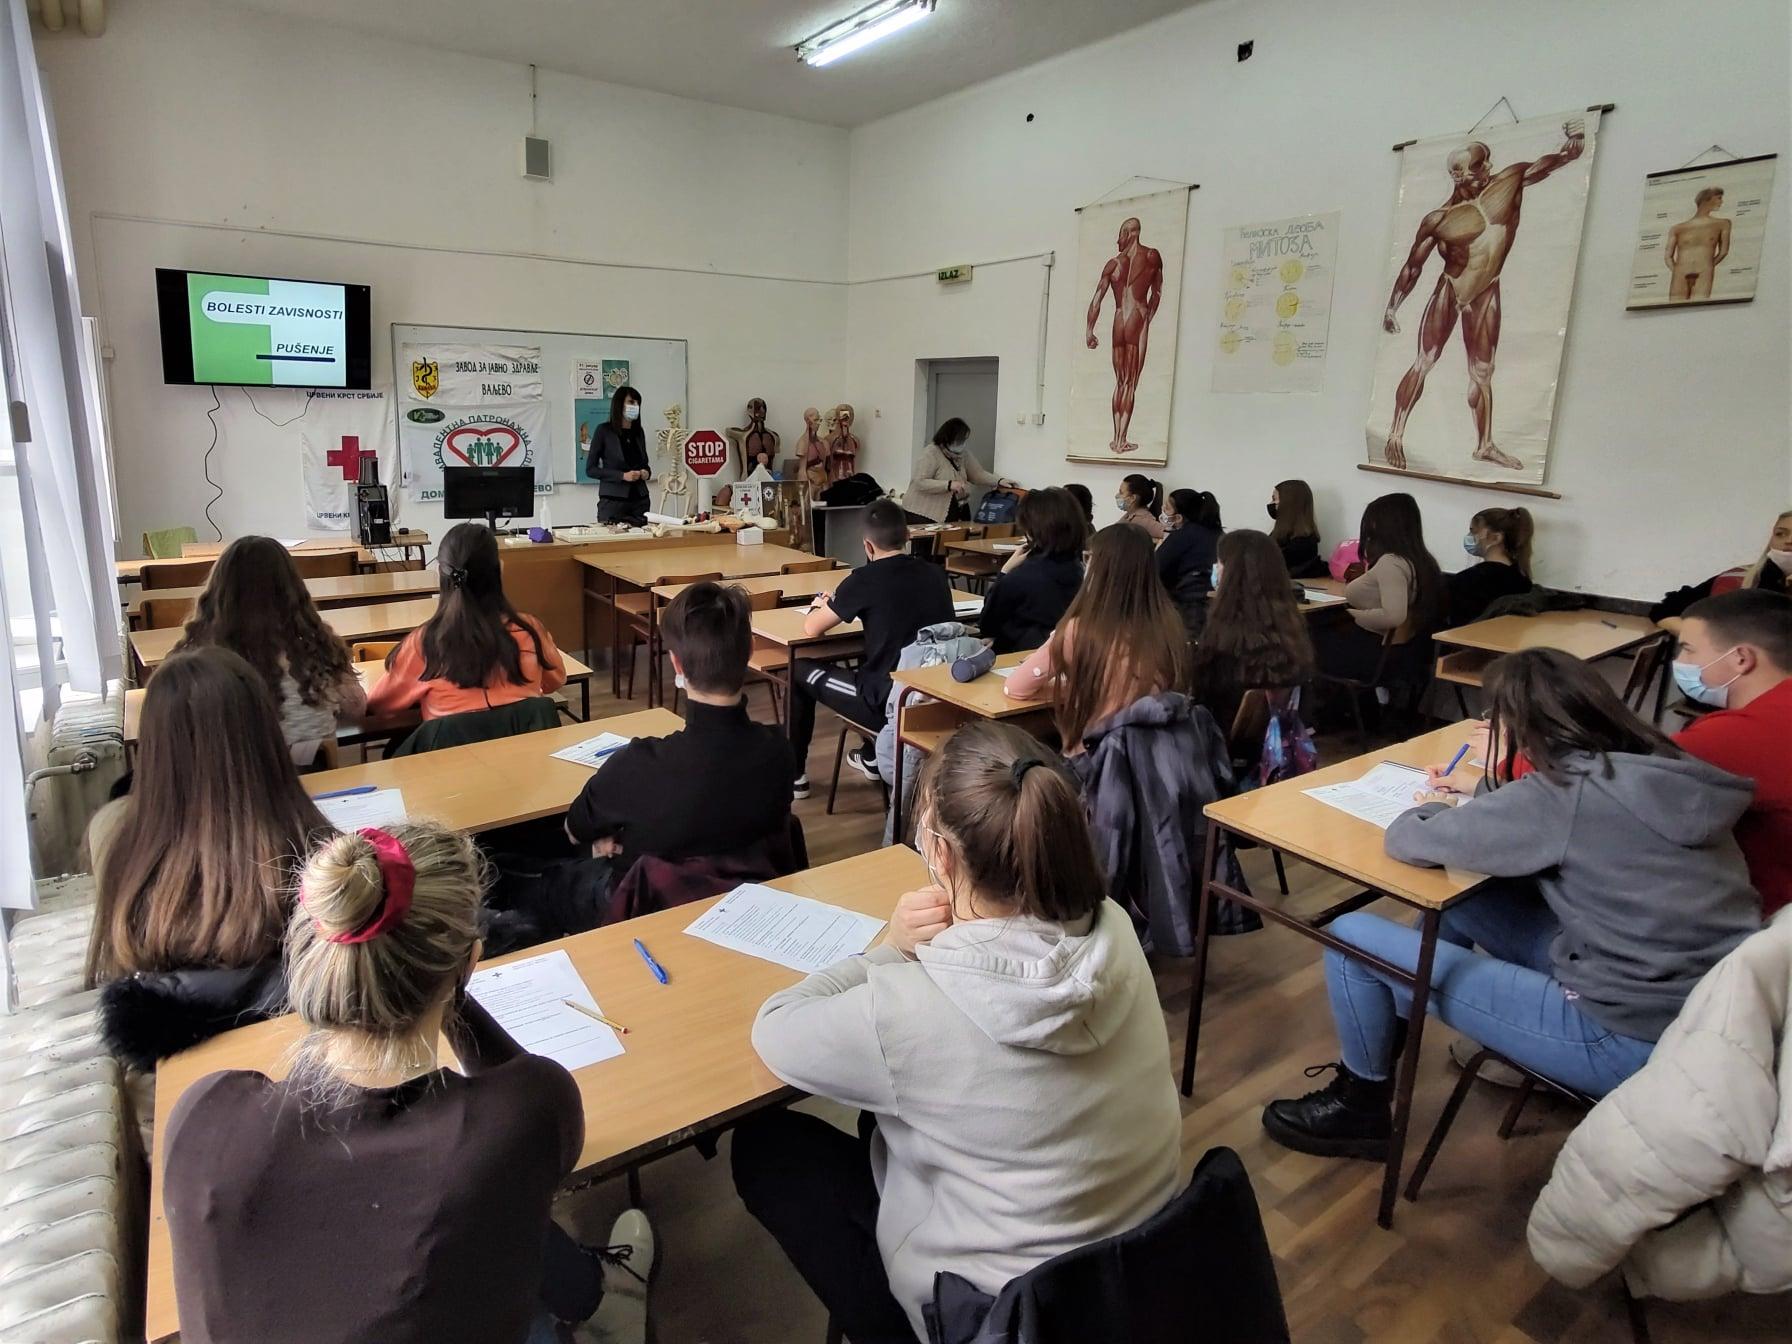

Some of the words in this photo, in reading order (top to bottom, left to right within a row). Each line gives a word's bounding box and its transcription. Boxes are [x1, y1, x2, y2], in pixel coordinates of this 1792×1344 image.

[1249, 234, 1313, 258] МИТОЗА
[938, 269, 959, 280] IZLAZ
[207, 301, 265, 315] BOLESTI
[269, 305, 343, 320] ZAVISNOSTI
[276, 342, 334, 355] PUŠENJE
[455, 361, 477, 373] ЗАВОД
[478, 361, 487, 372] ЗА
[488, 361, 508, 375] ЈАВНО
[511, 362, 539, 374] ЗДРАВЉЕ
[306, 391, 336, 399] ЦРВЕНИ
[337, 391, 355, 399] КРСТ
[357, 392, 384, 400] СРБИЈЕ
[481, 383, 512, 396] ВАЉЕВО
[468, 414, 533, 446] ПАТРОНАЖНА
[688, 441, 724, 457] STOP
[688, 456, 724, 465] CIGARETAMA
[316, 511, 342, 519] ЦРВЕНИ
